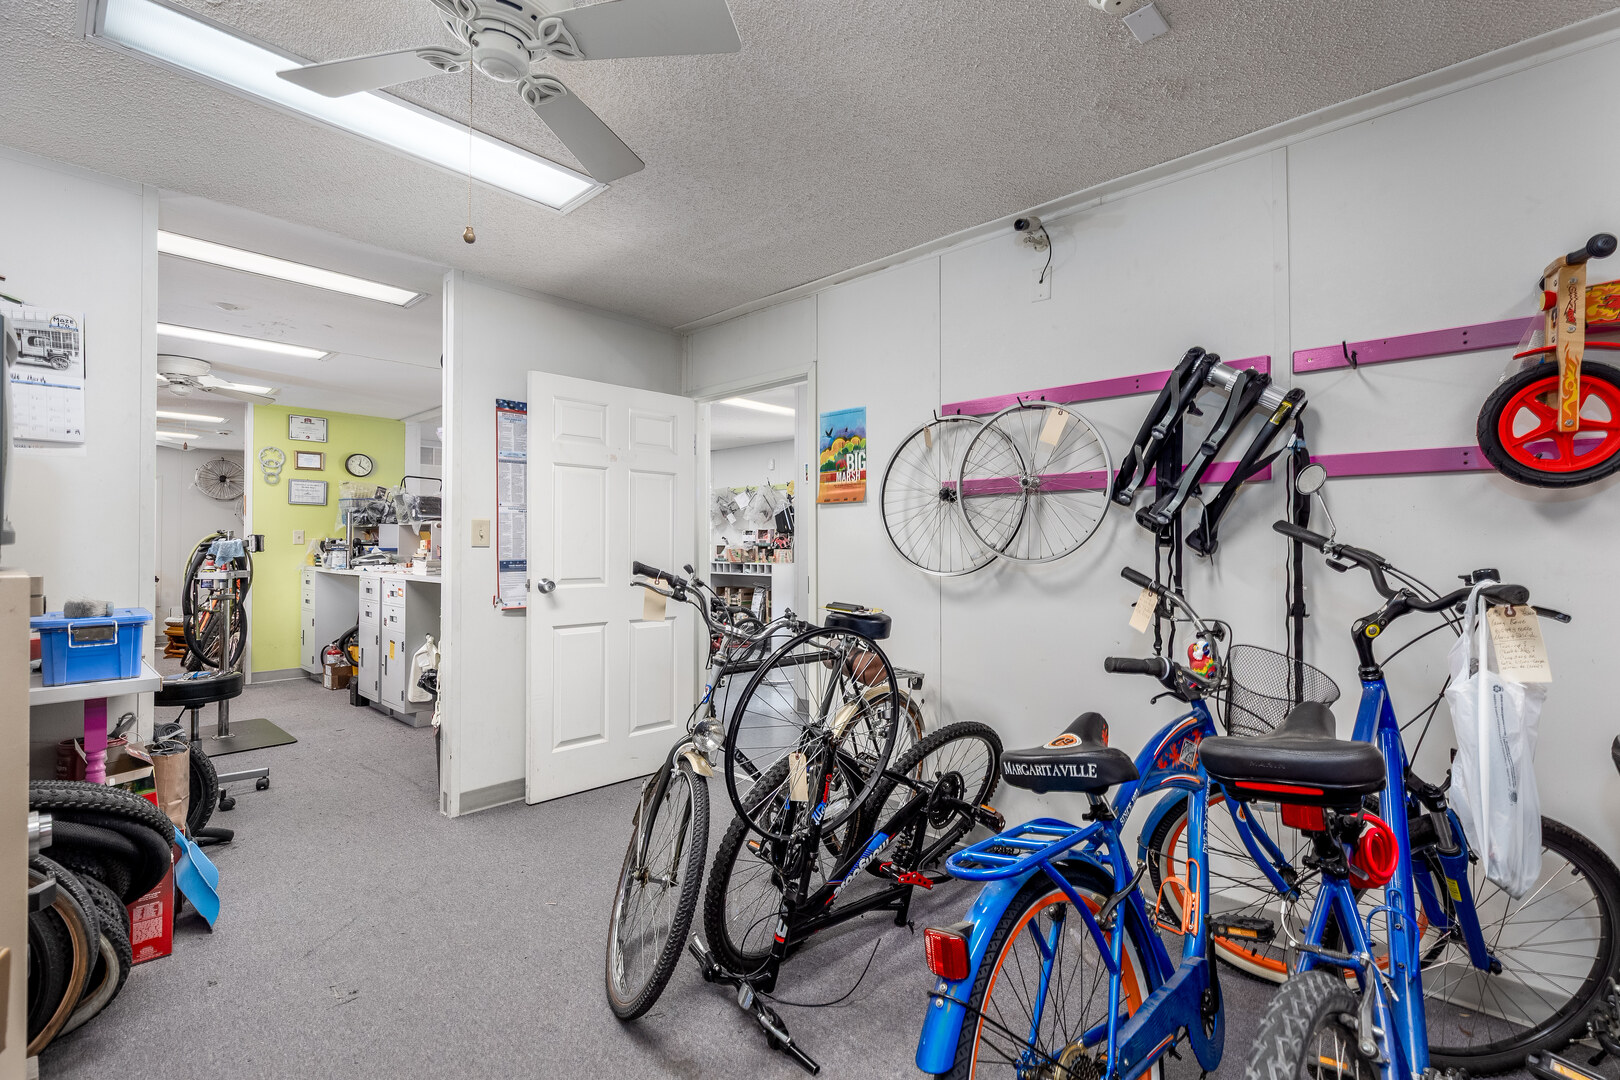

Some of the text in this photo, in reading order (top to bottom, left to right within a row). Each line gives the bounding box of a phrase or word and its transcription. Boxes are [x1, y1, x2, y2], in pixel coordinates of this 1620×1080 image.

[846, 451, 866, 472] BIG
[836, 470, 861, 483] MARSH
[1003, 761, 1098, 779] MARGARITAVILLE
[833, 838, 890, 898] mongoose
